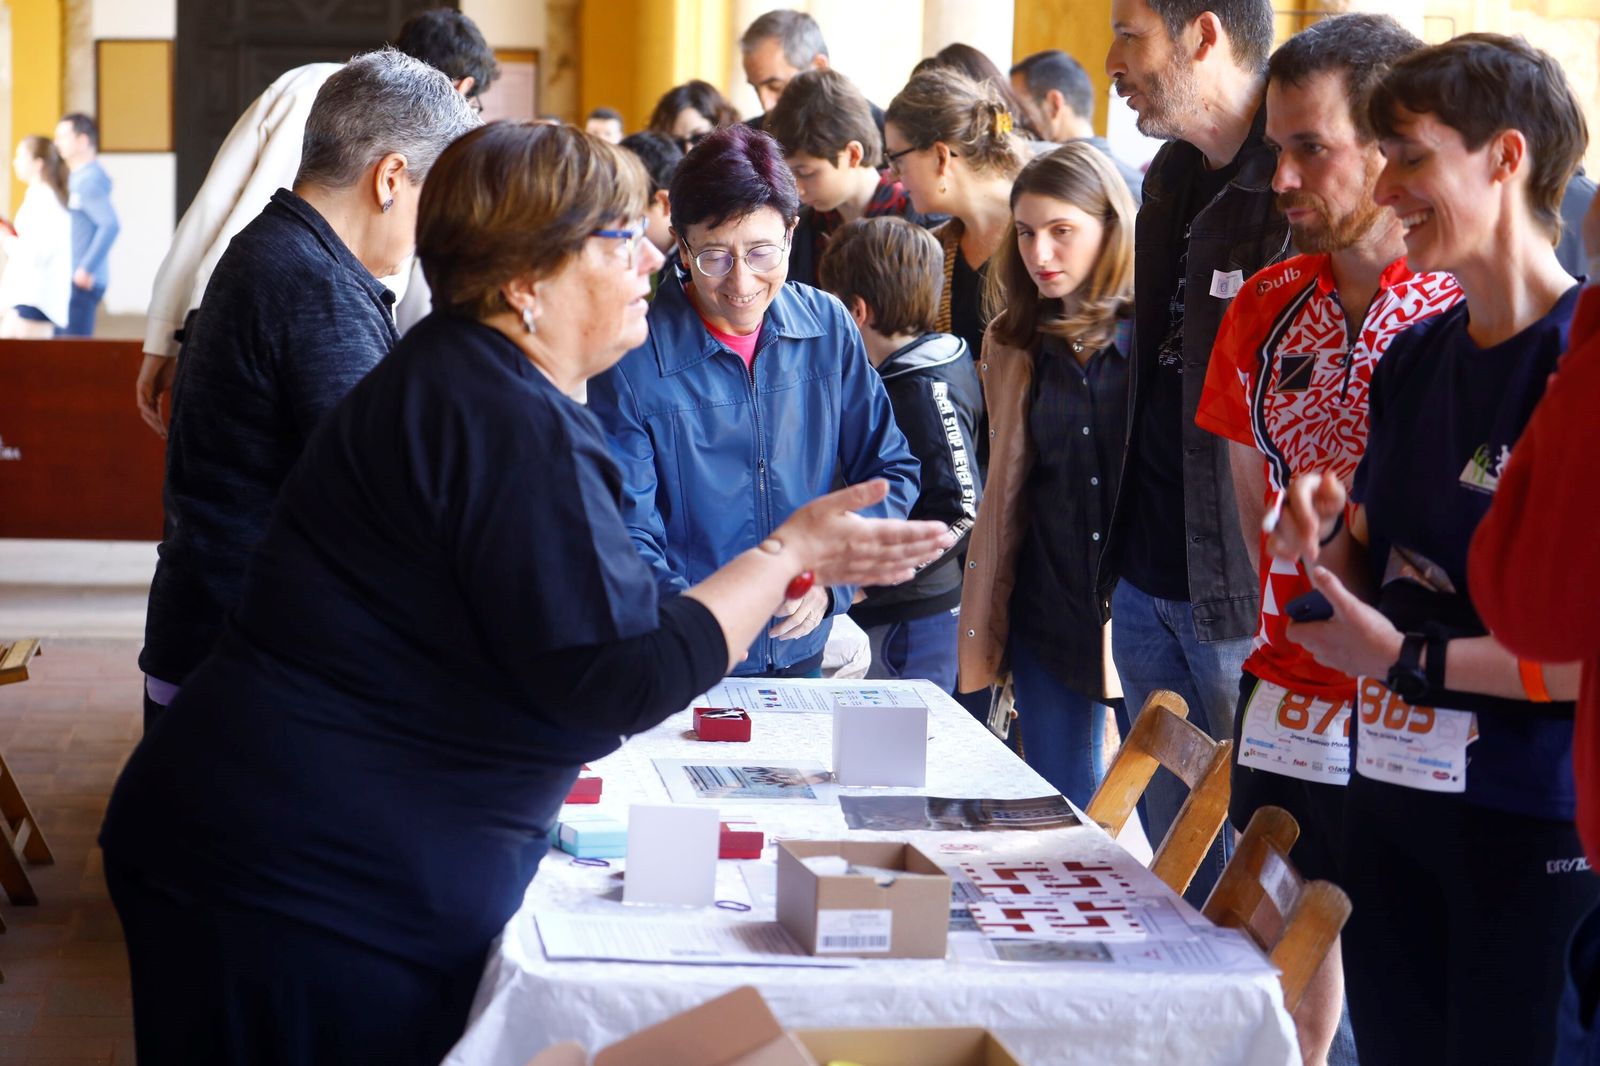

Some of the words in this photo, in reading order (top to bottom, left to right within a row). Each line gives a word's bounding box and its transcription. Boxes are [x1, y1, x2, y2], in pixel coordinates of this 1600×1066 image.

[944, 417, 964, 448] STOP
[953, 450, 973, 489] NEVER
[1279, 691, 1351, 736] 87
[1361, 678, 1436, 735] 865
